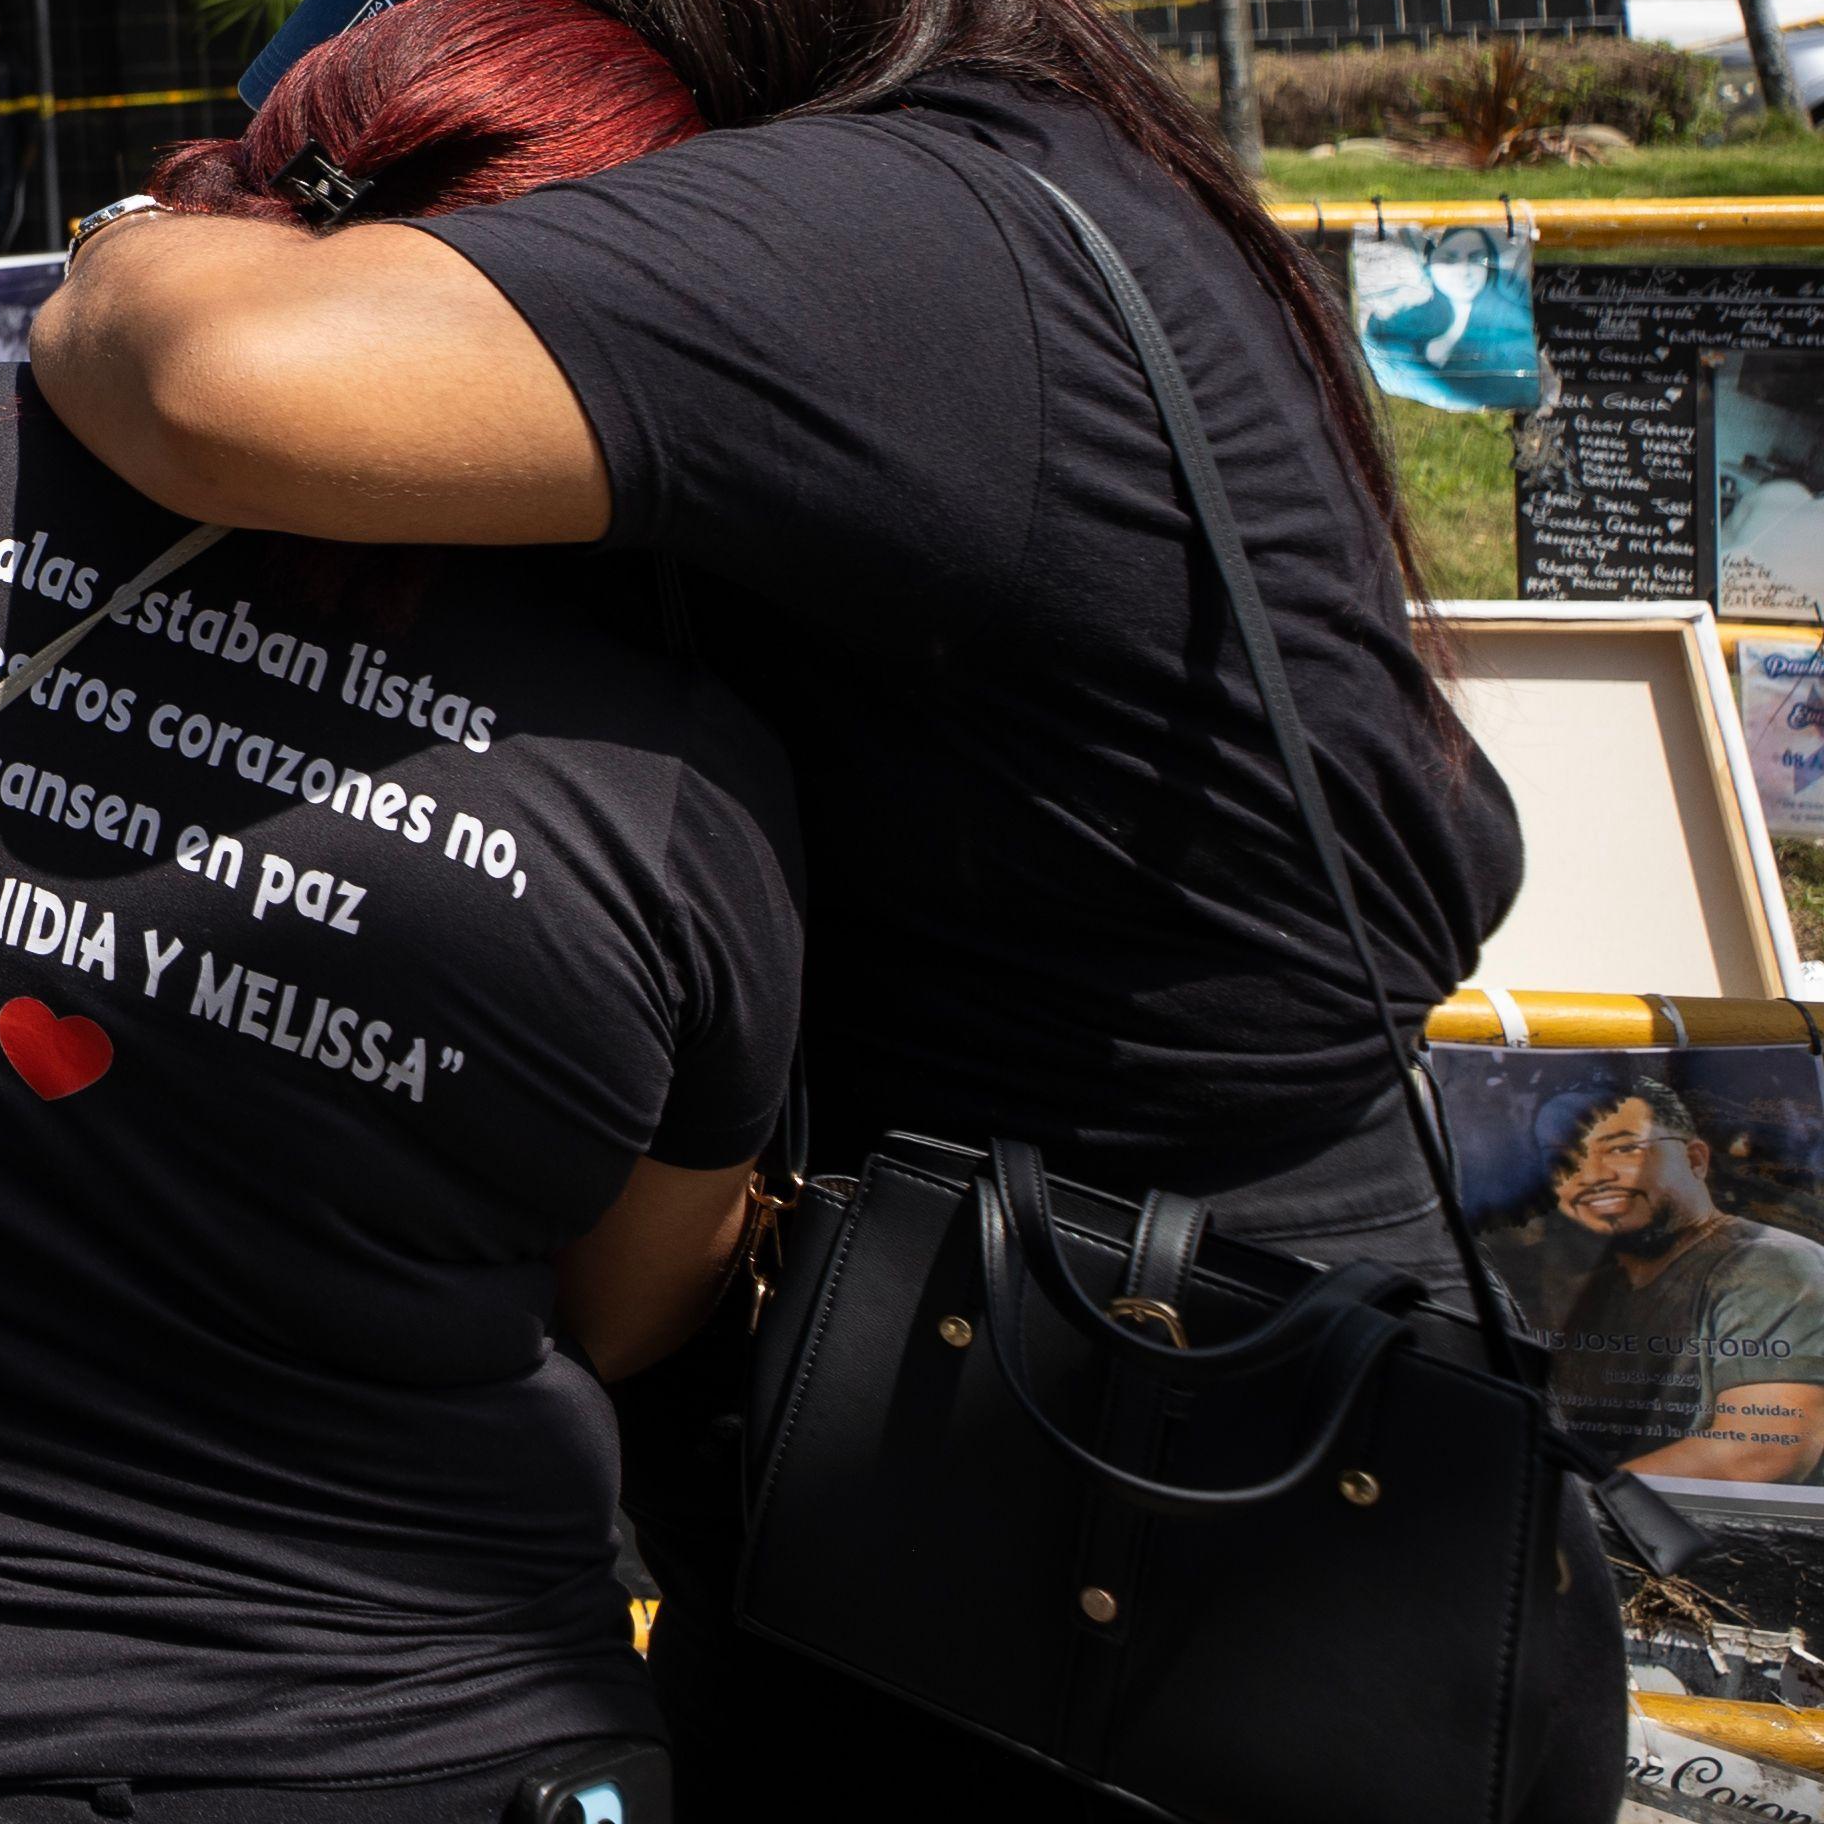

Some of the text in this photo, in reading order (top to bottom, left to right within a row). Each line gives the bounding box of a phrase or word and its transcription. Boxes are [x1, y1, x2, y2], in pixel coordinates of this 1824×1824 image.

[341, 642, 497, 753] listas
[147, 702, 436, 842] corazones
[444, 813, 528, 899] no,
[176, 825, 242, 888] en
[253, 854, 368, 936] paz
[141, 929, 184, 998] Y
[1572, 1331, 1640, 1355] JOSE
[1646, 1334, 1793, 1360] CUSTODIO
[1684, 1426, 1746, 1442] muerte
[1715, 1401, 1737, 1416] de
